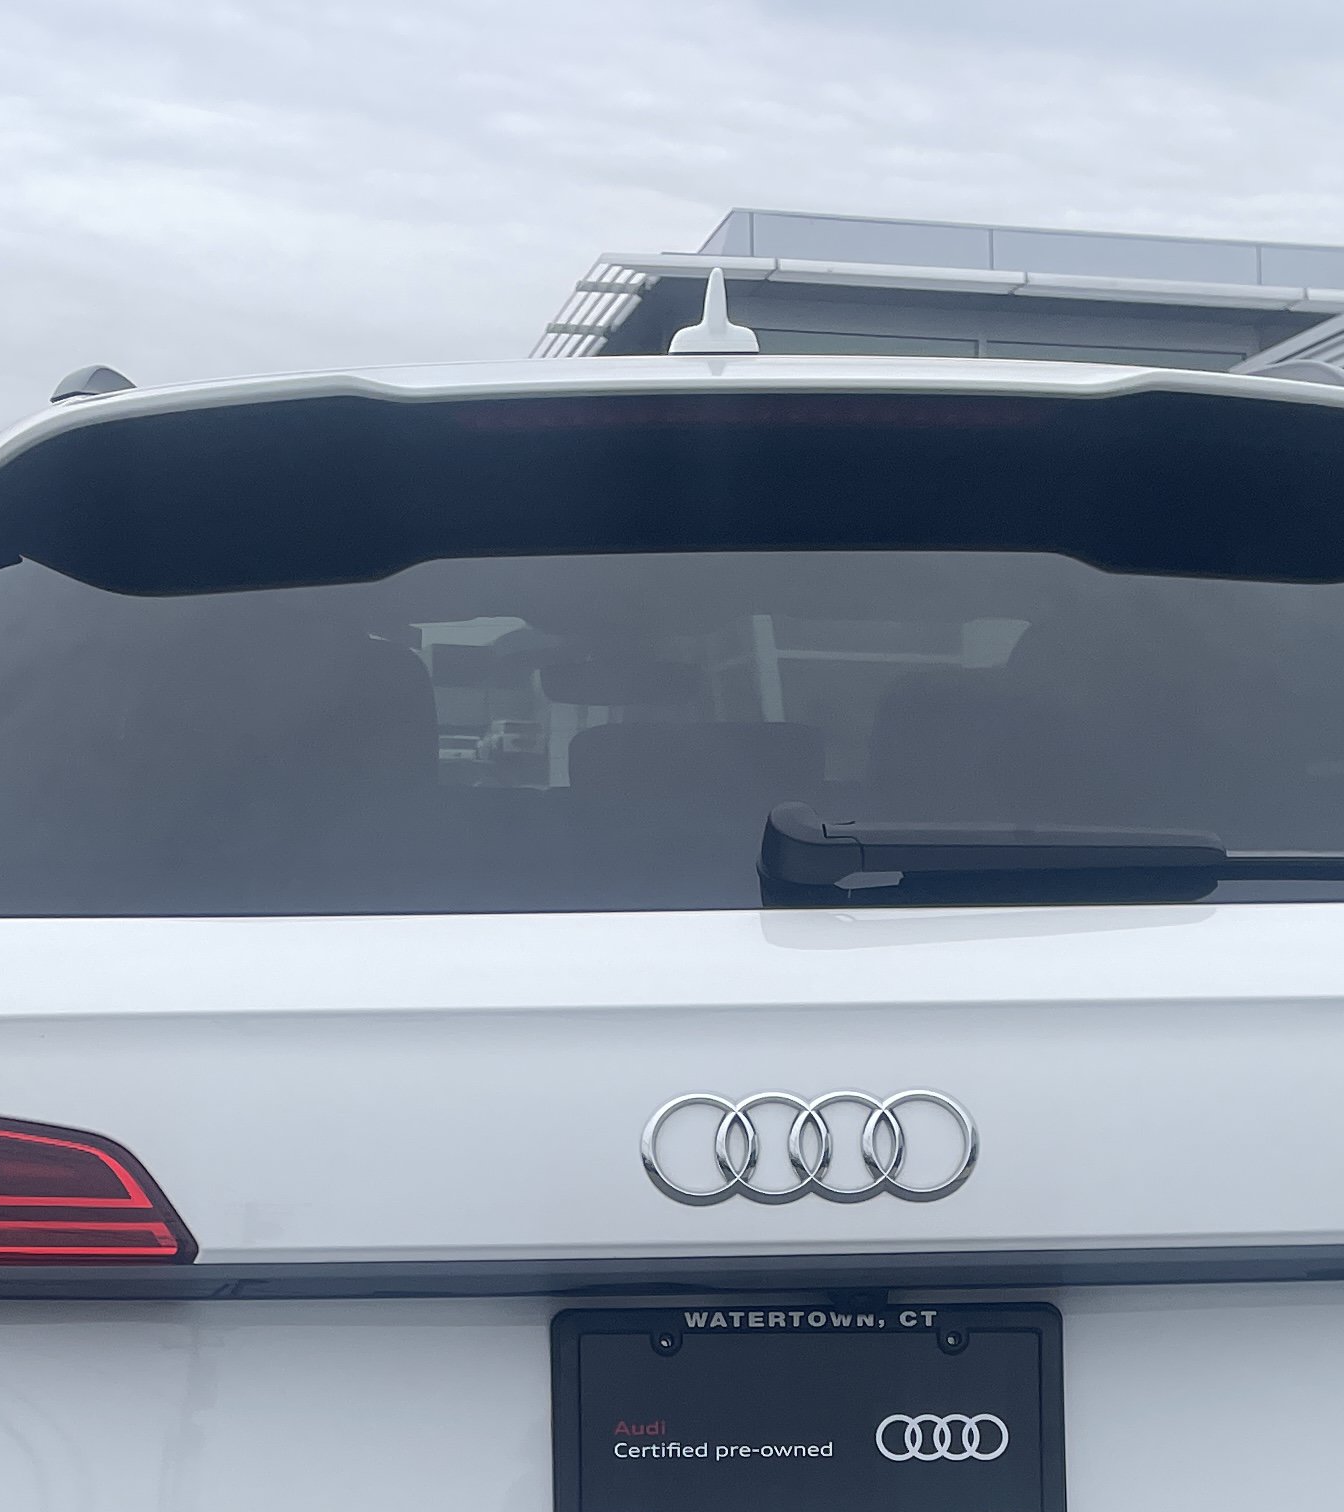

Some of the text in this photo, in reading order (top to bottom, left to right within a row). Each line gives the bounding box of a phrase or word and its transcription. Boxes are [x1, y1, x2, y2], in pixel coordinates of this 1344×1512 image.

[684, 1310, 937, 1328] WATERTOWN, CT
[614, 1421, 666, 1436] Audi
[614, 1441, 833, 1461] Certified pre-owned
